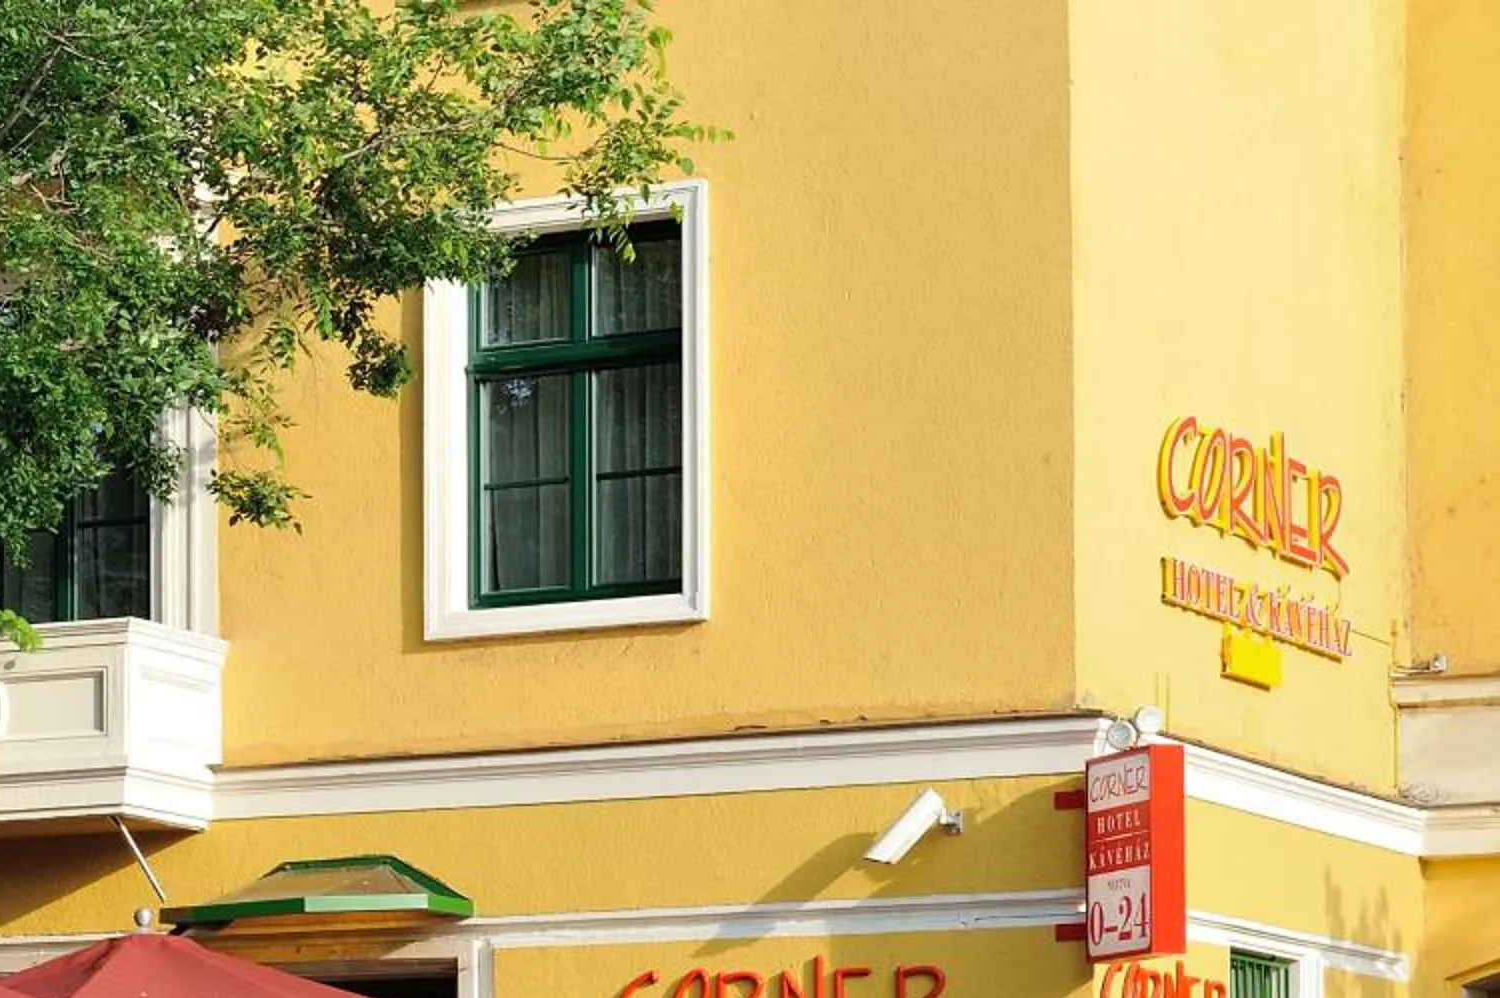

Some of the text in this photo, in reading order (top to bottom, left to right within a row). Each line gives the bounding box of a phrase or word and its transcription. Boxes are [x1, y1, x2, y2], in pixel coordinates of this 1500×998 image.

[1158, 416, 1350, 578] CORNER
[1162, 556, 1240, 620] HOTEL
[1090, 765, 1148, 803] CORNER
[1097, 809, 1141, 834] HOTEL
